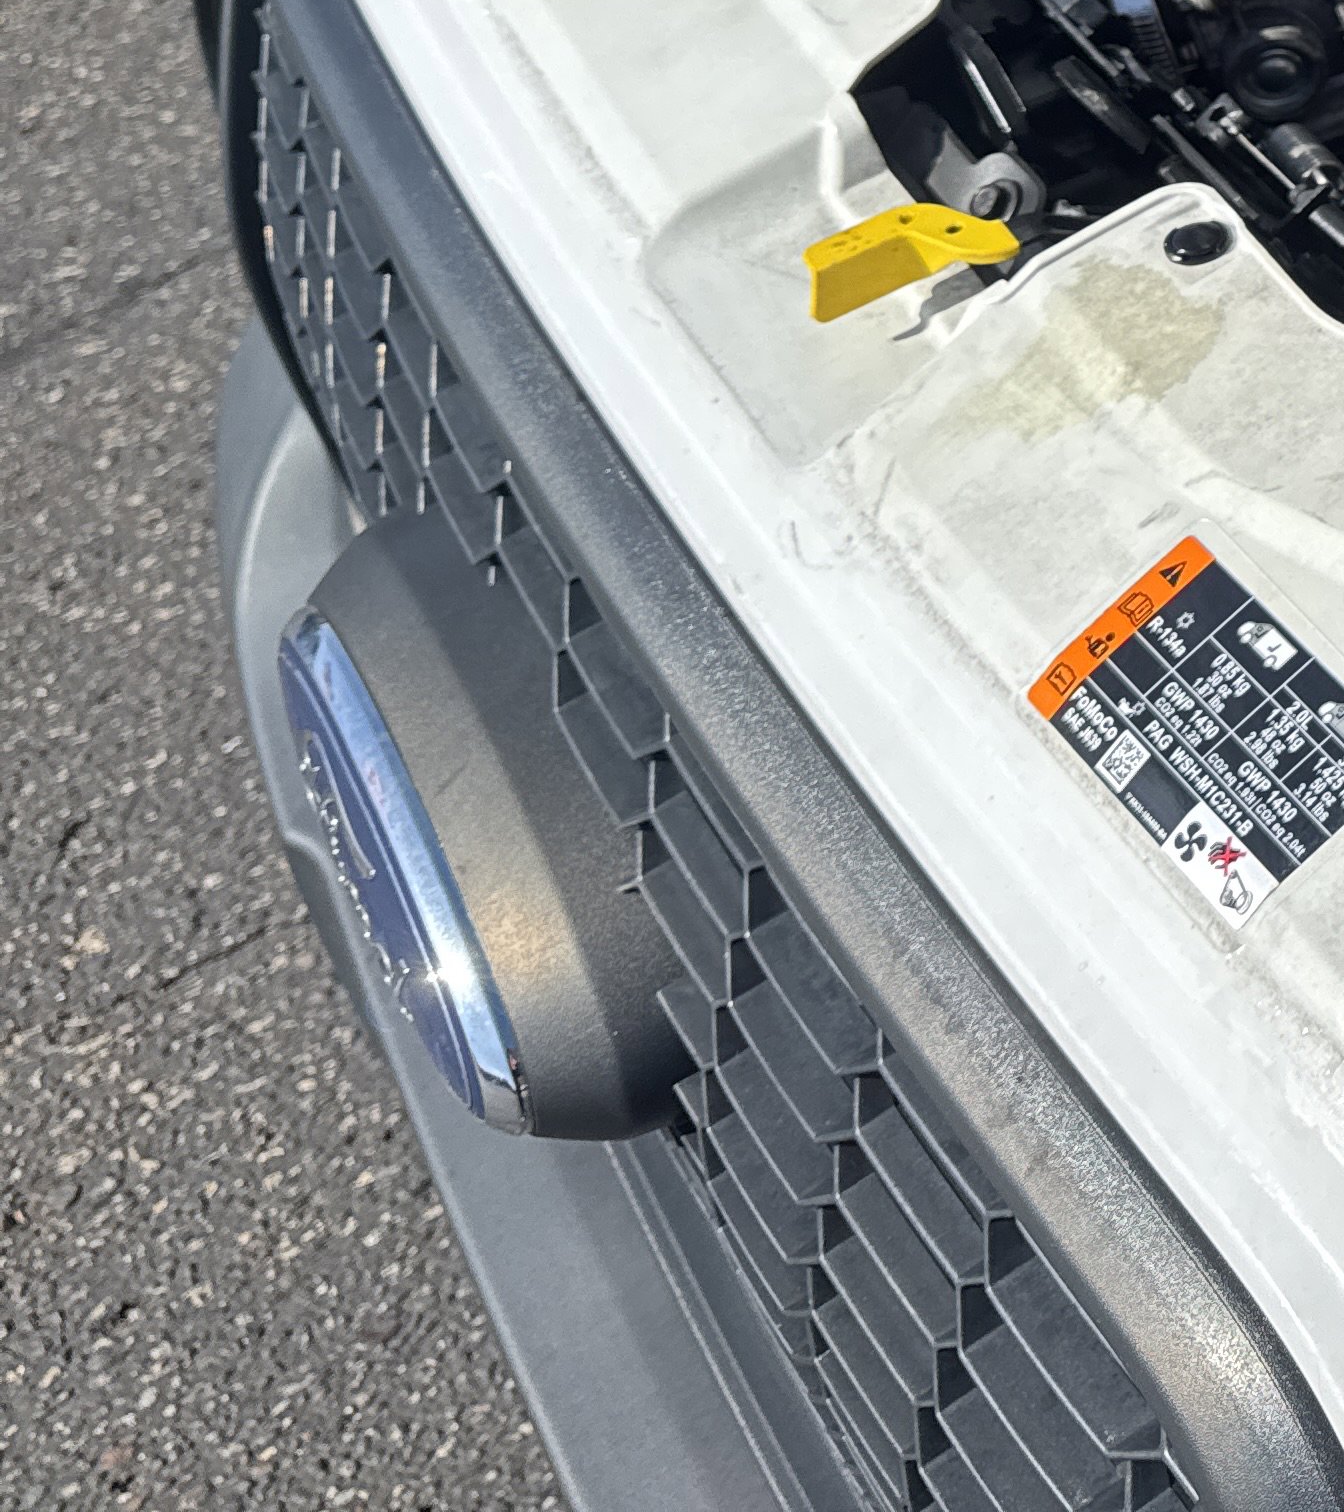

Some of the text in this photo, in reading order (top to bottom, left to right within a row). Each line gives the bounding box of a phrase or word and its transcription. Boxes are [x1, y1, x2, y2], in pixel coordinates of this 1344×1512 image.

[1146, 615, 1186, 657] R-134a
[1205, 671, 1232, 699] 30 oz
[1231, 673, 1251, 696] kg
[1061, 706, 1085, 732] SAE
[1069, 685, 1117, 741] FoMoCo
[1162, 681, 1219, 739] GWP 1430
[1285, 700, 1312, 730] 2.0L
[1266, 708, 1305, 752] 1.35 kg
[1270, 738, 1286, 755] oz
[1142, 719, 1173, 750] PAG
[1169, 746, 1252, 836] WSH-M1C231-B
[1237, 760, 1297, 822] GWP 1430
[1320, 790, 1337, 807] oz
